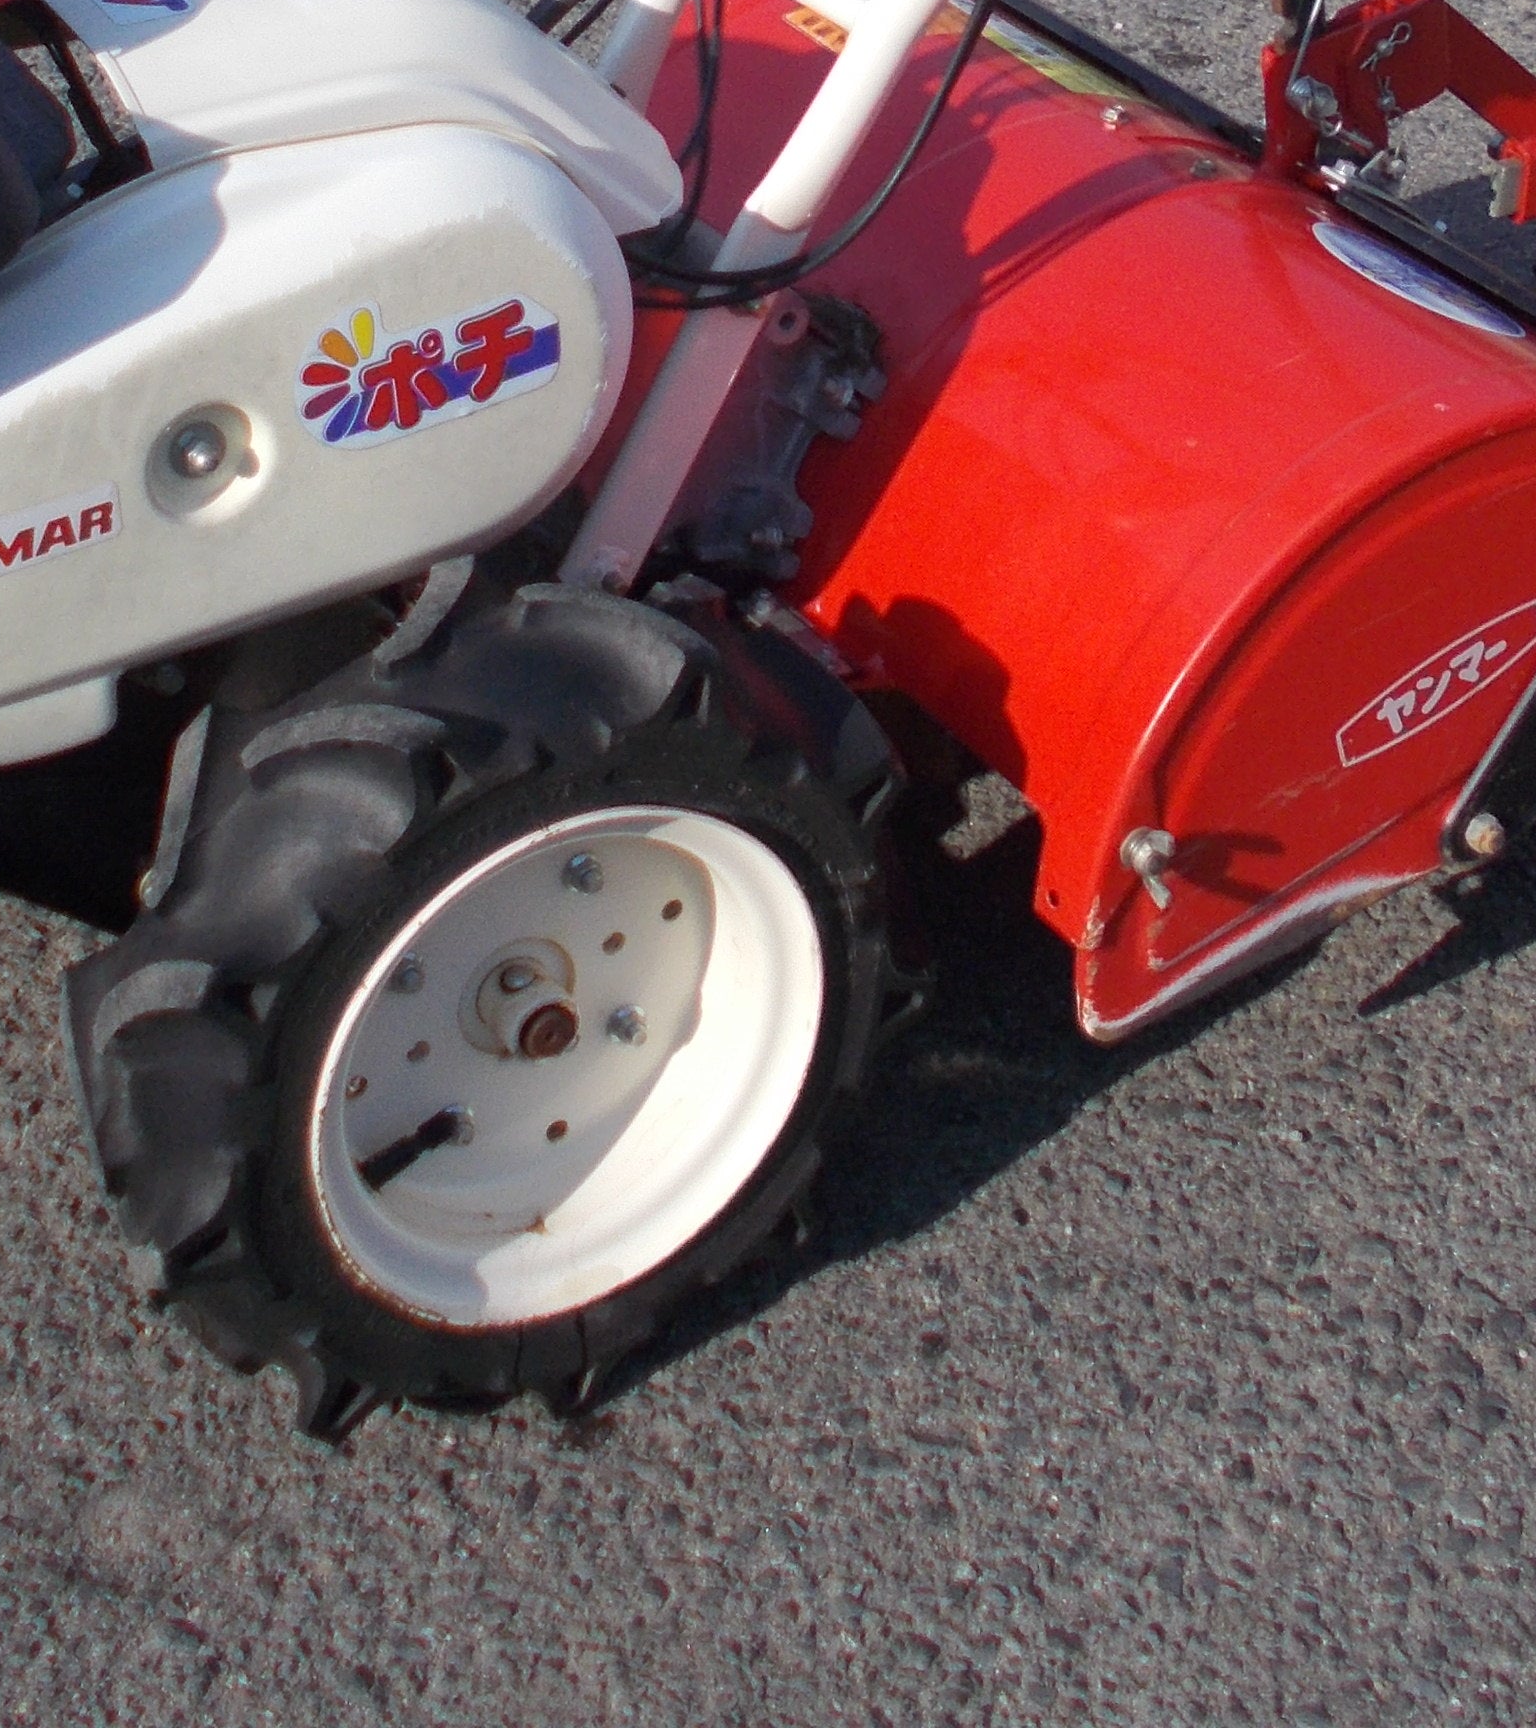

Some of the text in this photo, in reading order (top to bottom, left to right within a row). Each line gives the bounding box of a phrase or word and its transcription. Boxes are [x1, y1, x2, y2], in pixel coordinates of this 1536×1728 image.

[361, 298, 535, 432] ポチ
[1376, 639, 1507, 734] ヤンマー
